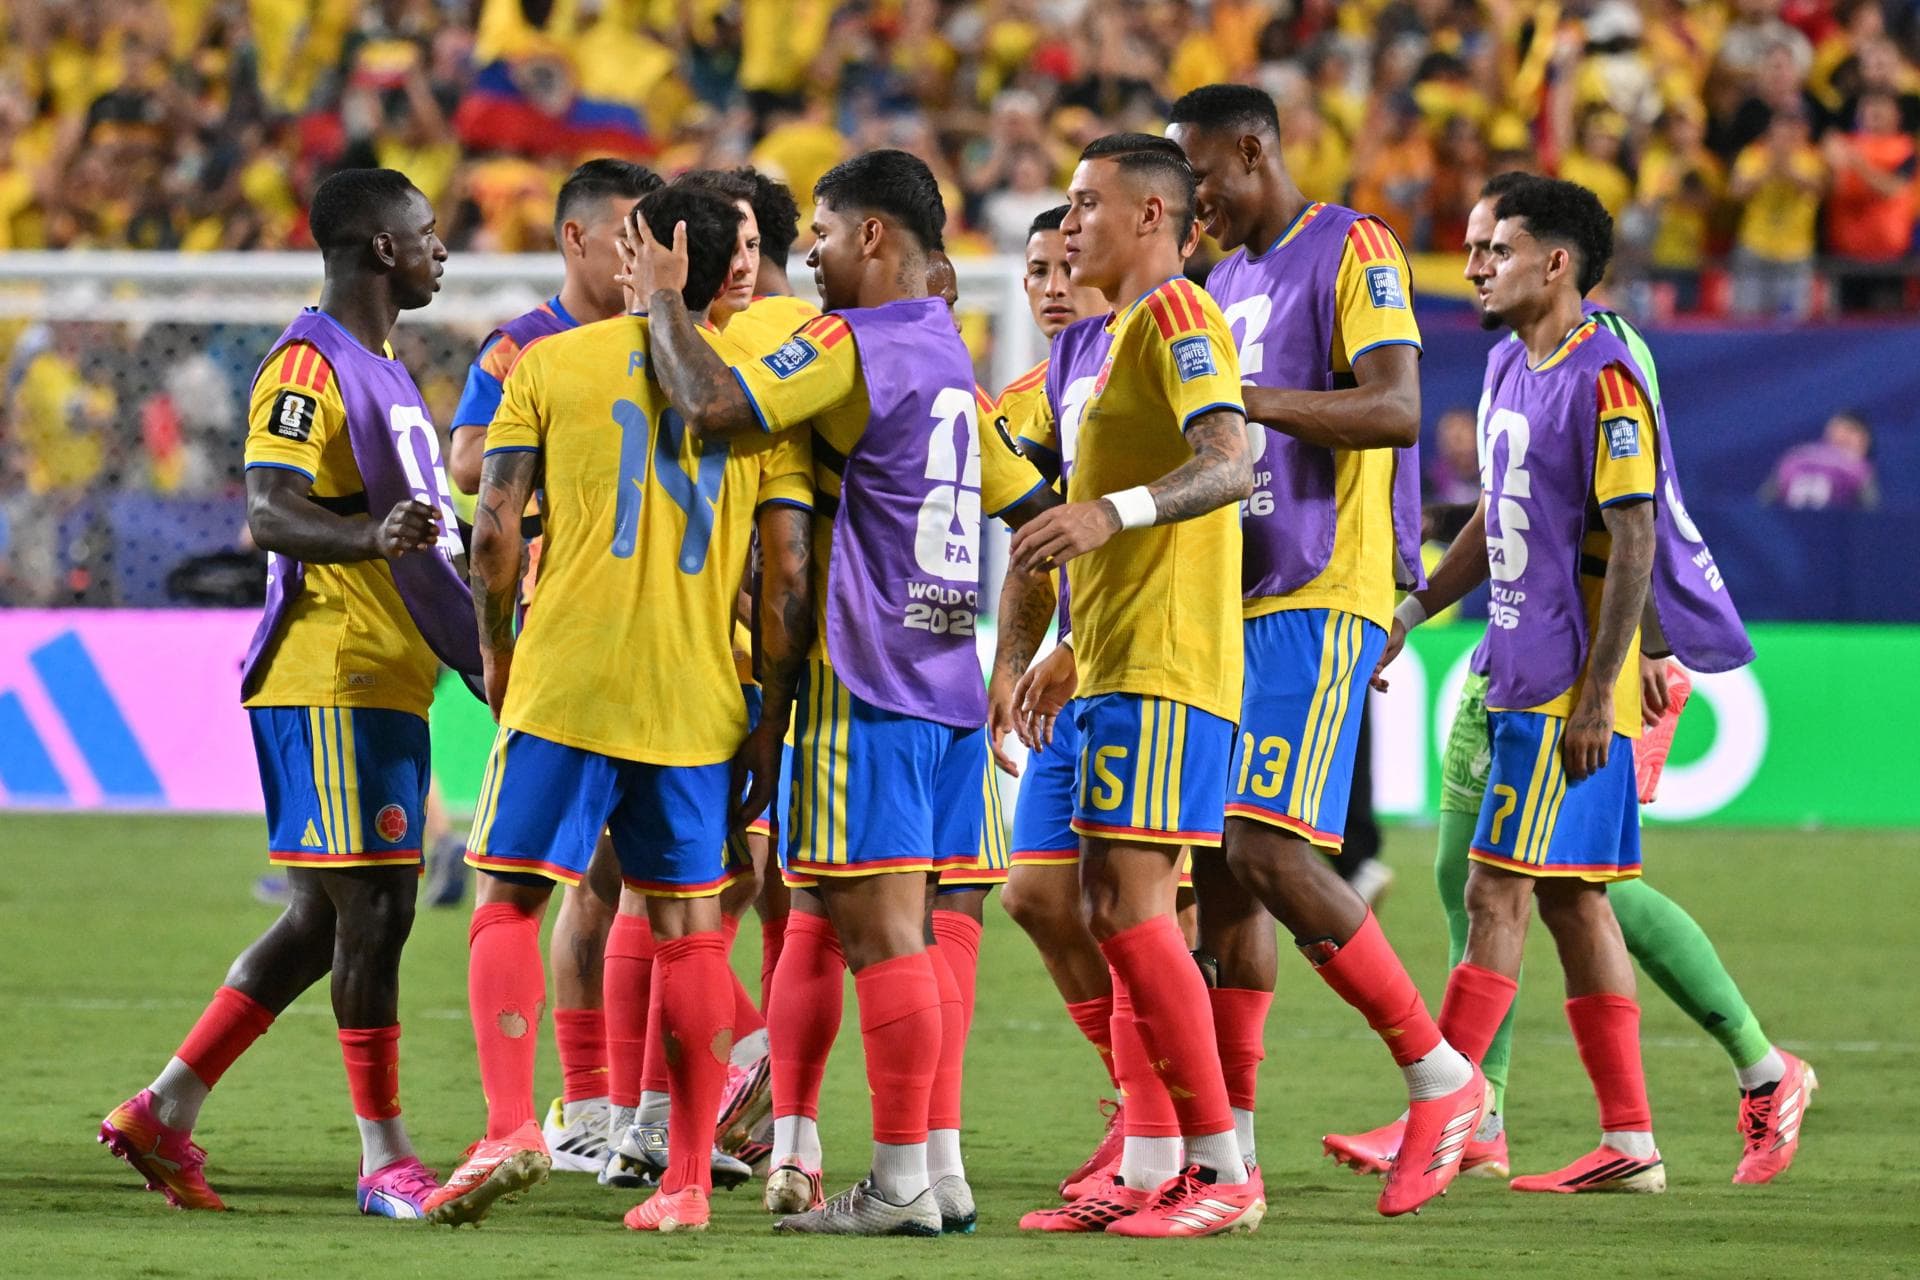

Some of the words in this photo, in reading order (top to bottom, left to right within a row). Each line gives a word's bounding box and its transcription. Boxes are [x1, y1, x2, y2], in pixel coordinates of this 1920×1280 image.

[611, 399, 729, 574] 14
[903, 603, 977, 636] 202
[1236, 731, 1291, 798] 13
[1491, 784, 1516, 845] 7
